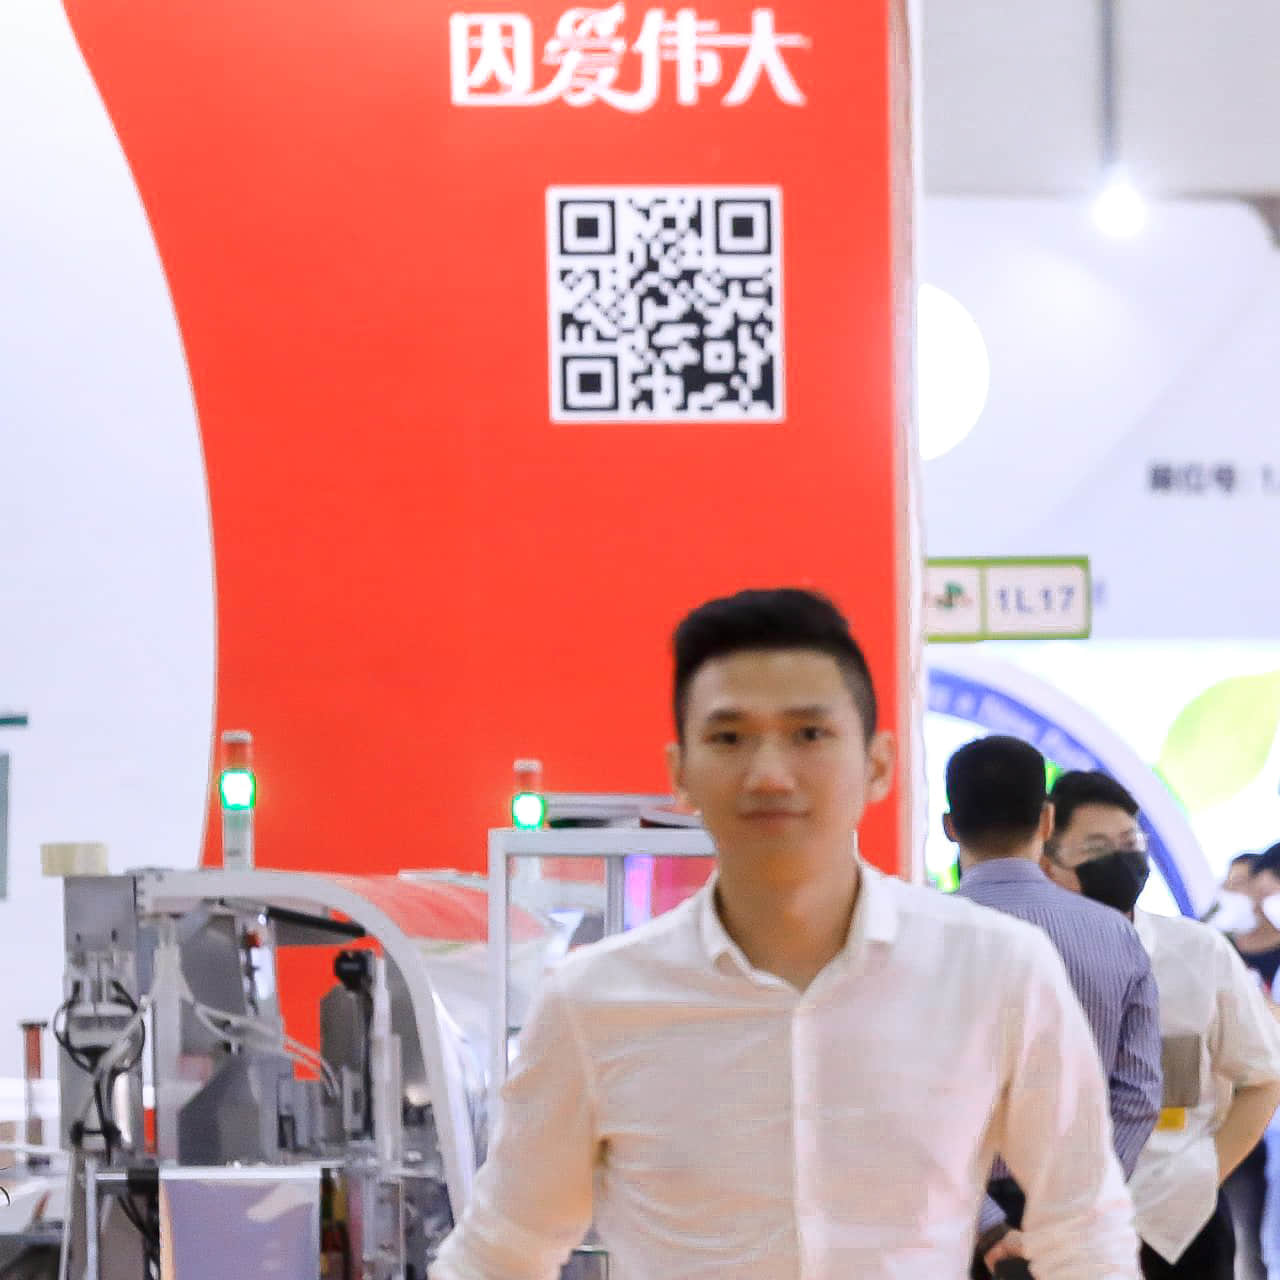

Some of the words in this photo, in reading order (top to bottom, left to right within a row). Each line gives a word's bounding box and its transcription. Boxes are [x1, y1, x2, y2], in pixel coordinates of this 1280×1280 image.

[450, 2, 812, 114] 因爱伟大
[997, 584, 1076, 614] 1L17
